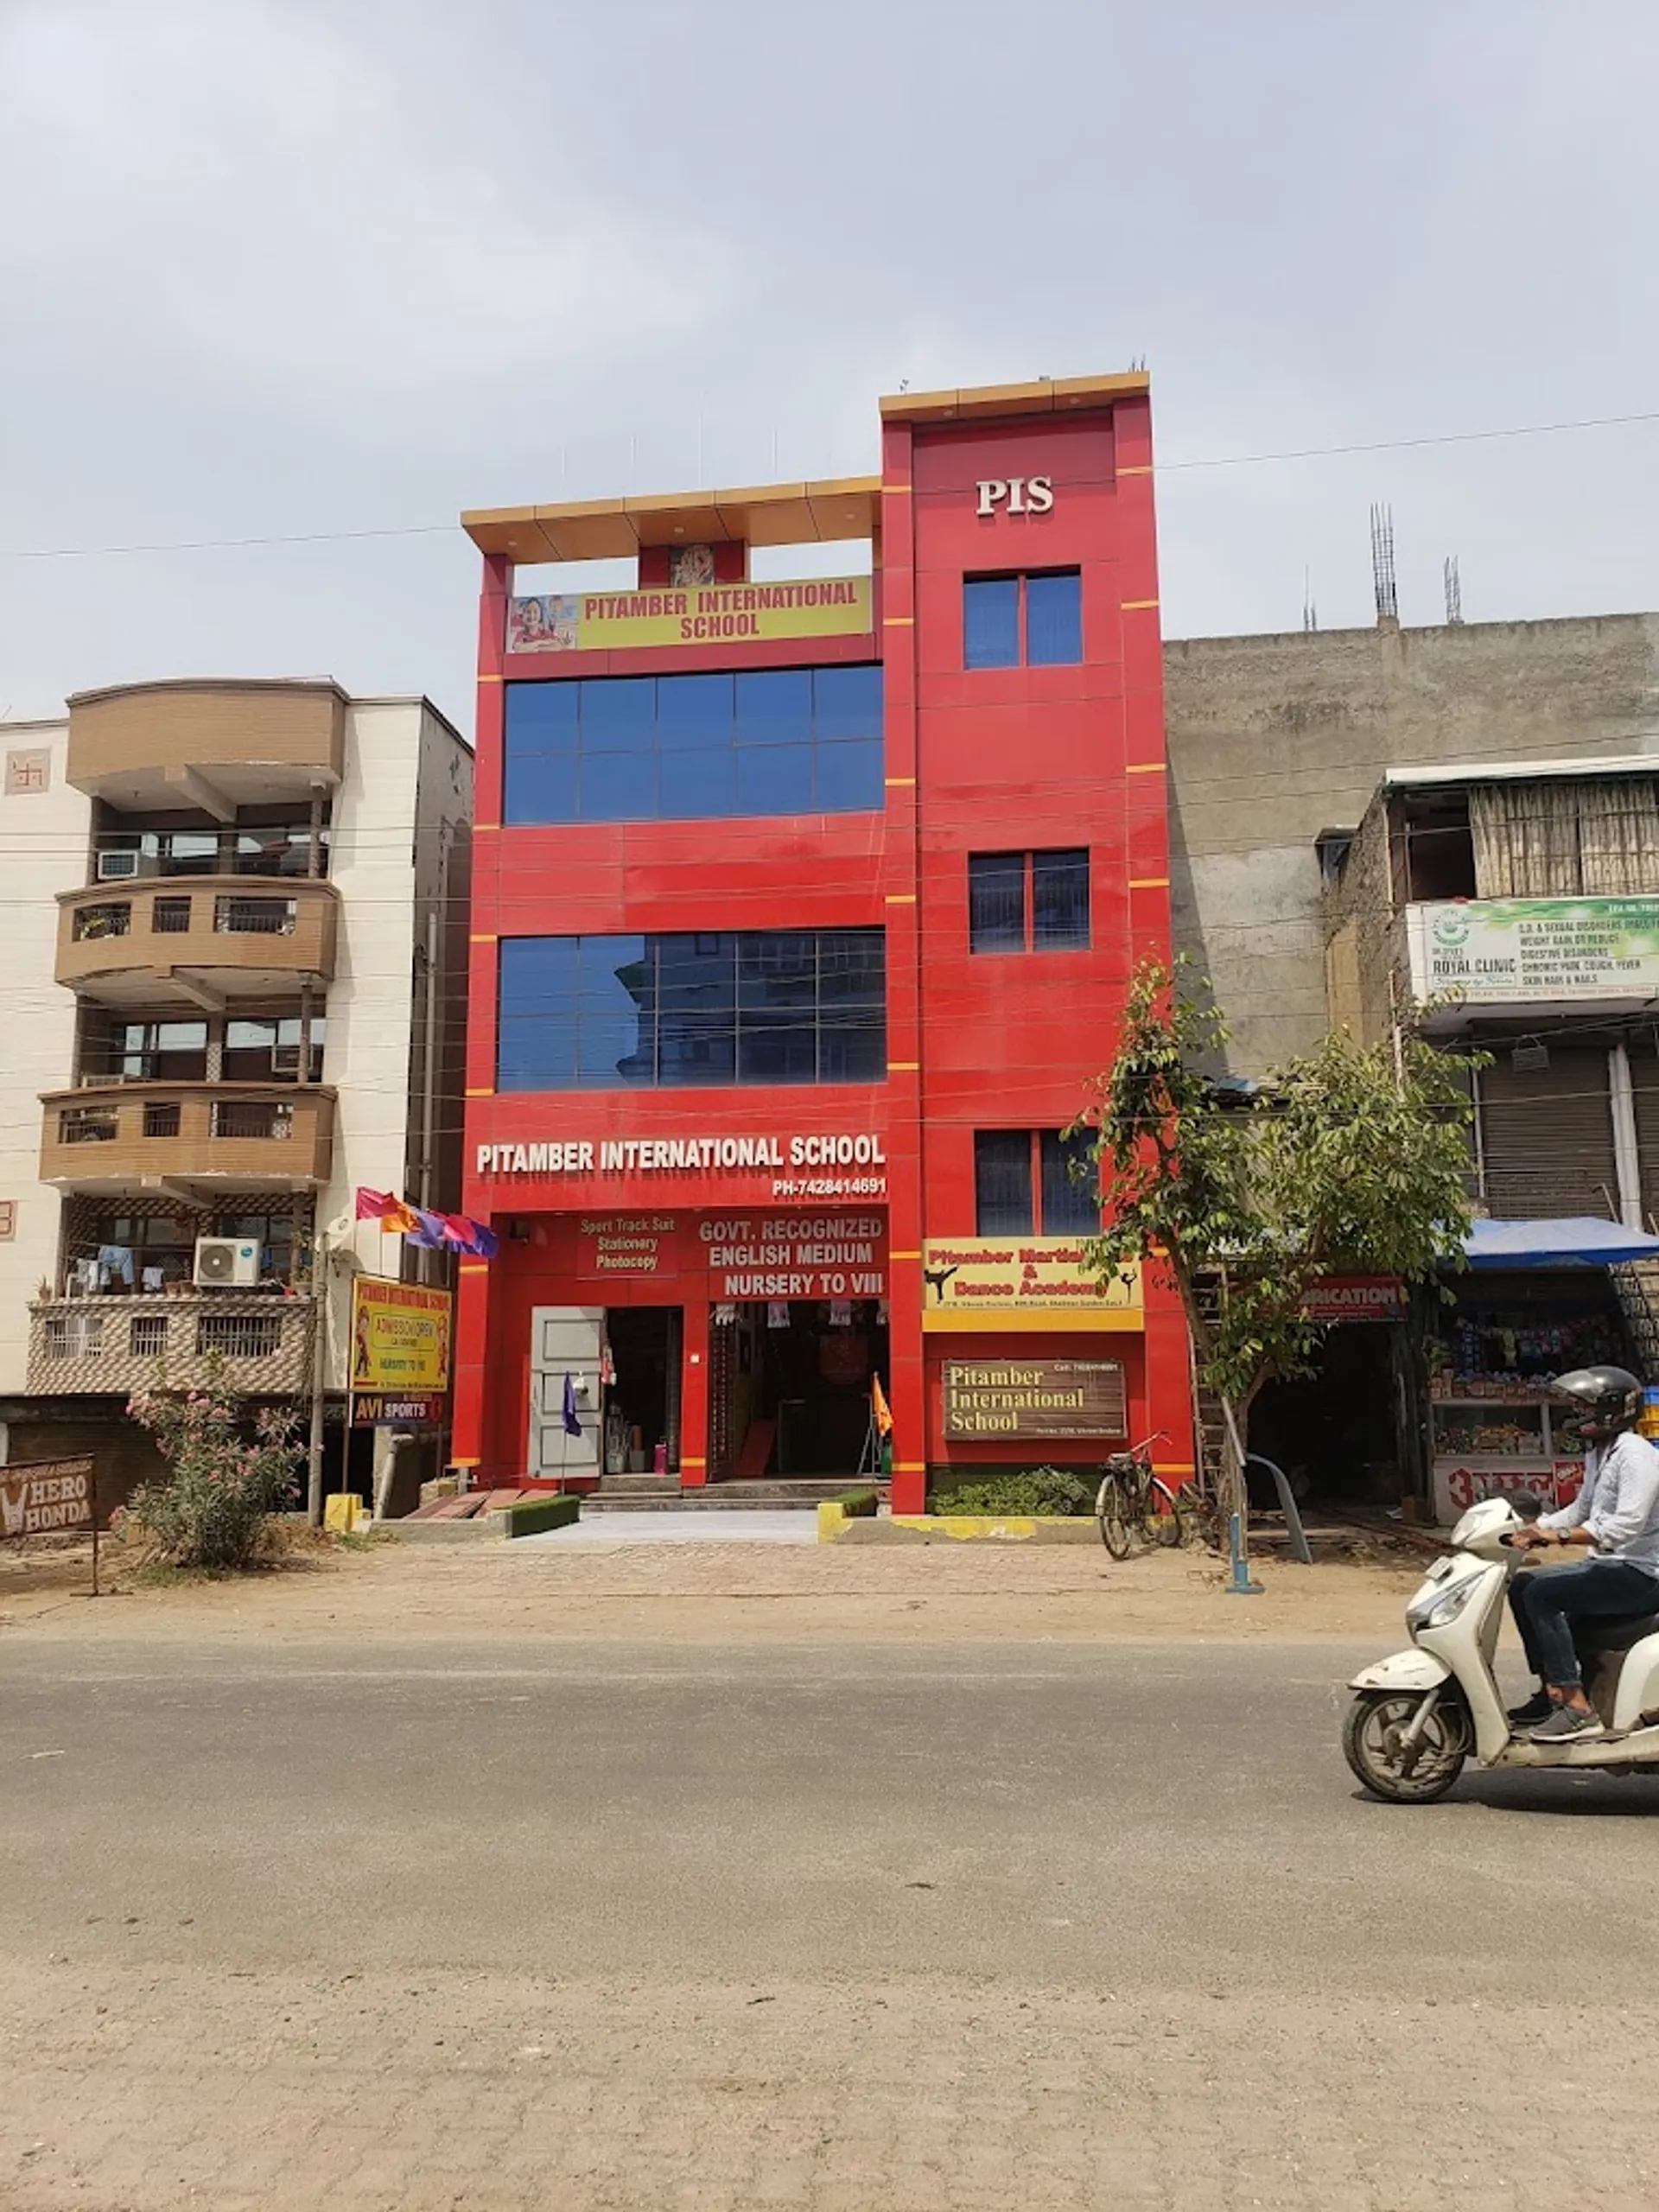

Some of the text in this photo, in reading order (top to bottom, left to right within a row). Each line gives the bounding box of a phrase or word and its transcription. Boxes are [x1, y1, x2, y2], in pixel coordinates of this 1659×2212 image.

[976, 476, 1053, 514] PIS
[585, 582, 857, 620] PITAMBER INTERNATIONAL
[680, 614, 760, 639] SCHOOL
[1433, 957, 1516, 975] ROYAL CLINIC
[476, 1135, 886, 1173] PITAMBER INTERNATIONAL SCHOOL
[581, 1216, 675, 1236] Sport Track Suit
[700, 1217, 882, 1242] GOVT. RECOGNIZED
[596, 1254, 658, 1271] Photocopy
[709, 1243, 873, 1268] ENGLISH MEDIUM
[928, 1249, 1014, 1265] Pitamber
[1023, 1264, 1038, 1279] &
[724, 1272, 882, 1296] NURSERY TO VIII
[954, 1281, 1014, 1296] Dance
[950, 1366, 1043, 1386] Pitamber
[950, 1387, 1084, 1408] International
[355, 1398, 426, 1420] AVI SPORTS
[950, 1410, 1019, 1432] School
[30, 1475, 86, 1505] HERO
[24, 1499, 92, 1532] HONDA
